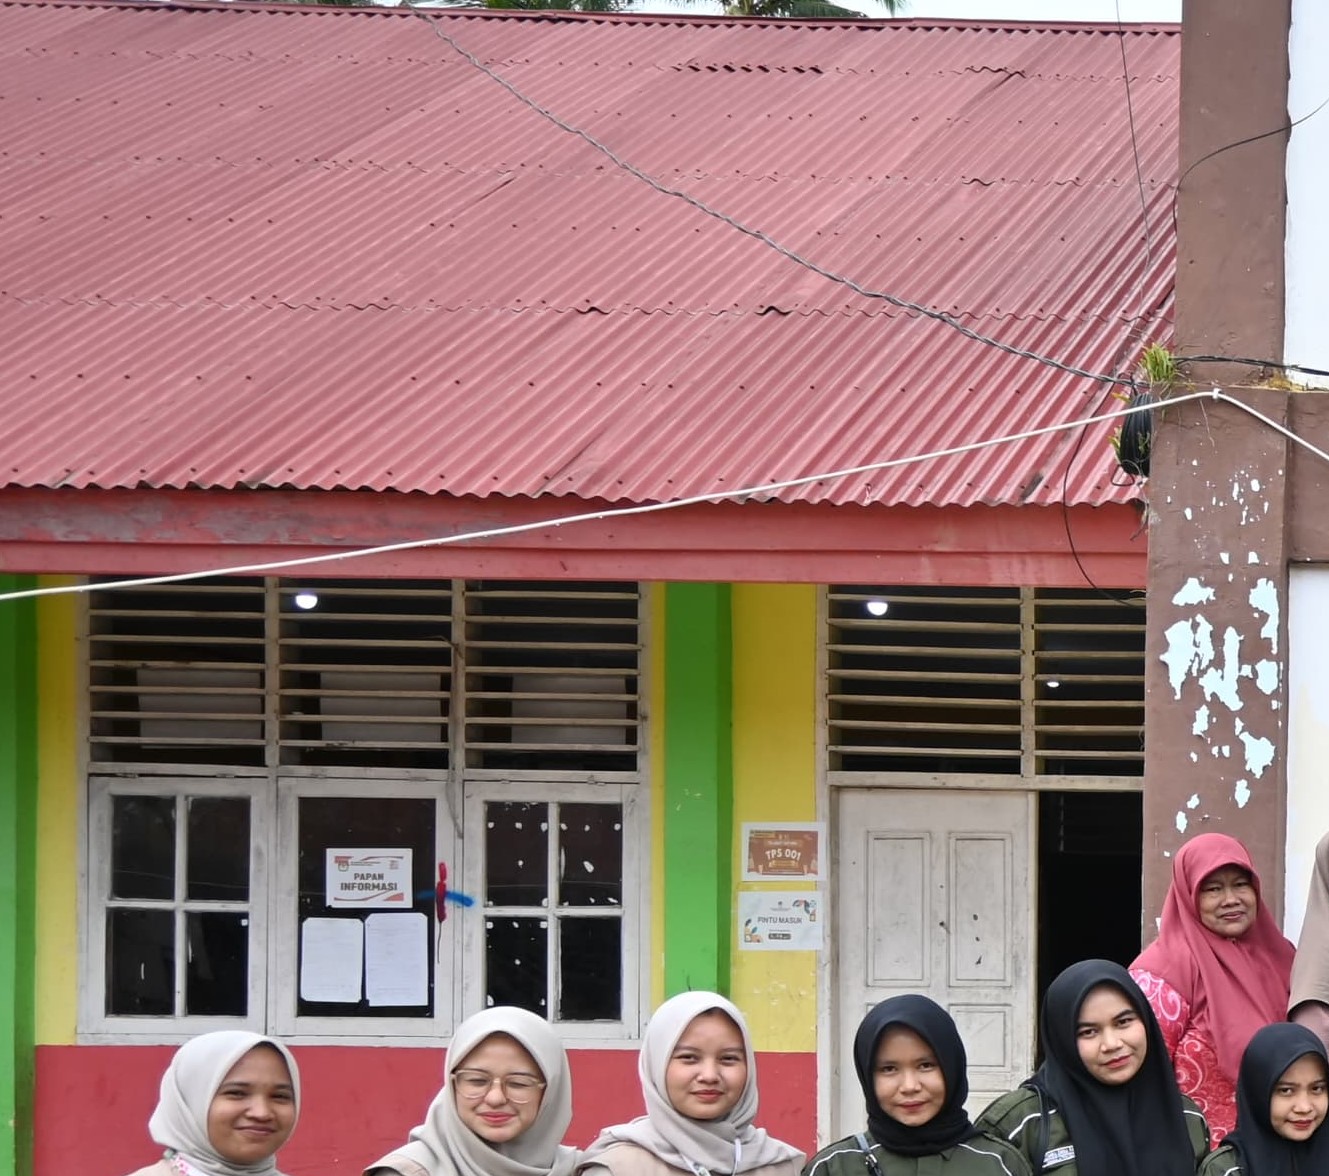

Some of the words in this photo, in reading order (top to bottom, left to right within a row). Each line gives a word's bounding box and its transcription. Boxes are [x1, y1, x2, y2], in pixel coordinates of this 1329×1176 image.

[765, 848, 782, 860] TPS
[784, 848, 801, 861] 001
[353, 872, 385, 881] PAPAN
[340, 882, 398, 891] INFORMASI
[757, 916, 778, 924] PINTU
[779, 916, 803, 924] MASUK
